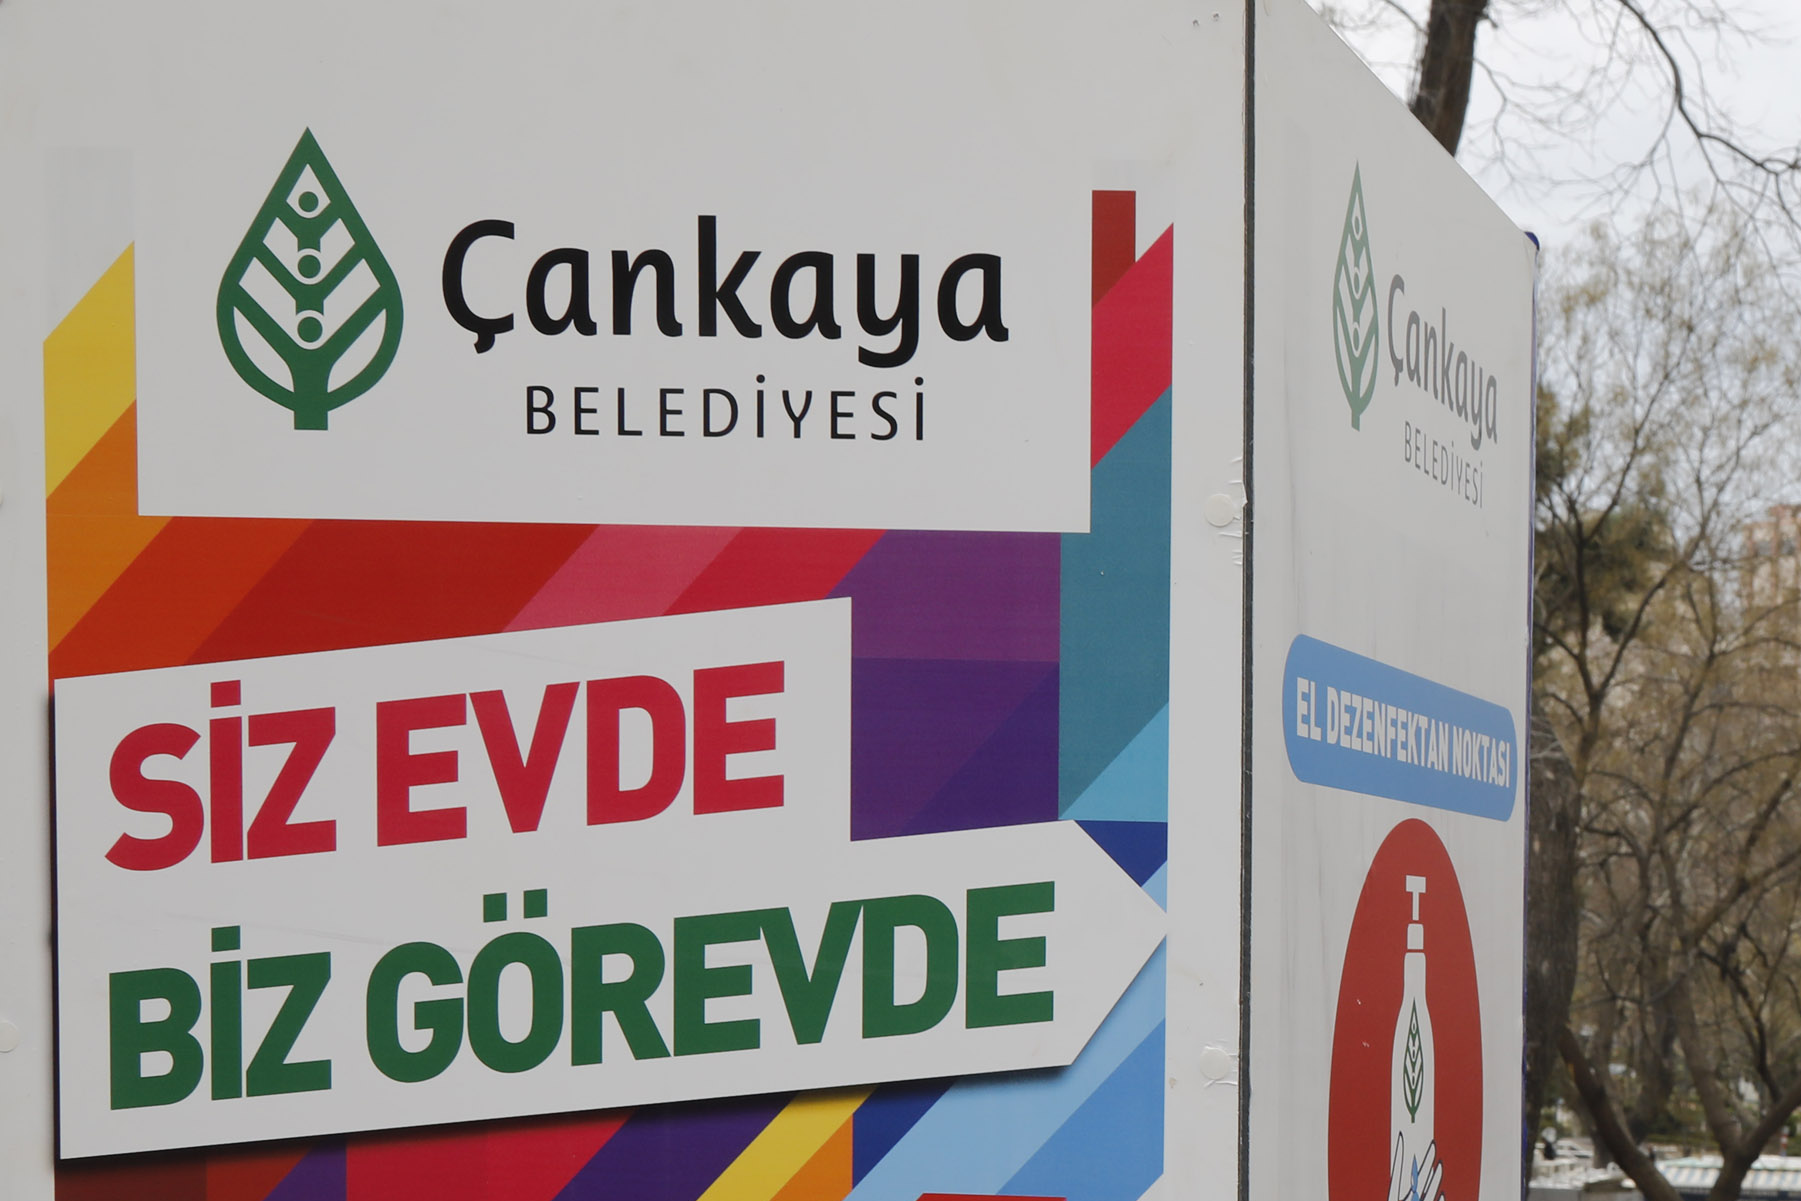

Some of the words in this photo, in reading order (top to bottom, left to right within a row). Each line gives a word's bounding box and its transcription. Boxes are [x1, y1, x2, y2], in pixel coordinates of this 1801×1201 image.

[441, 215, 1010, 368] Çankaya
[1387, 274, 1498, 451] Çankaya
[525, 374, 926, 440] BELEDİYESİ
[1404, 420, 1484, 509] BELEDİYESİ
[105, 680, 337, 871] SİZ
[376, 661, 785, 847] EVDE
[1297, 677, 1322, 741] EL
[1327, 686, 1449, 773] DEZENFEKTAN
[1453, 725, 1510, 788] NOKTASI
[109, 925, 332, 1110] BİZ
[366, 880, 1055, 1083] GÖREVDE
